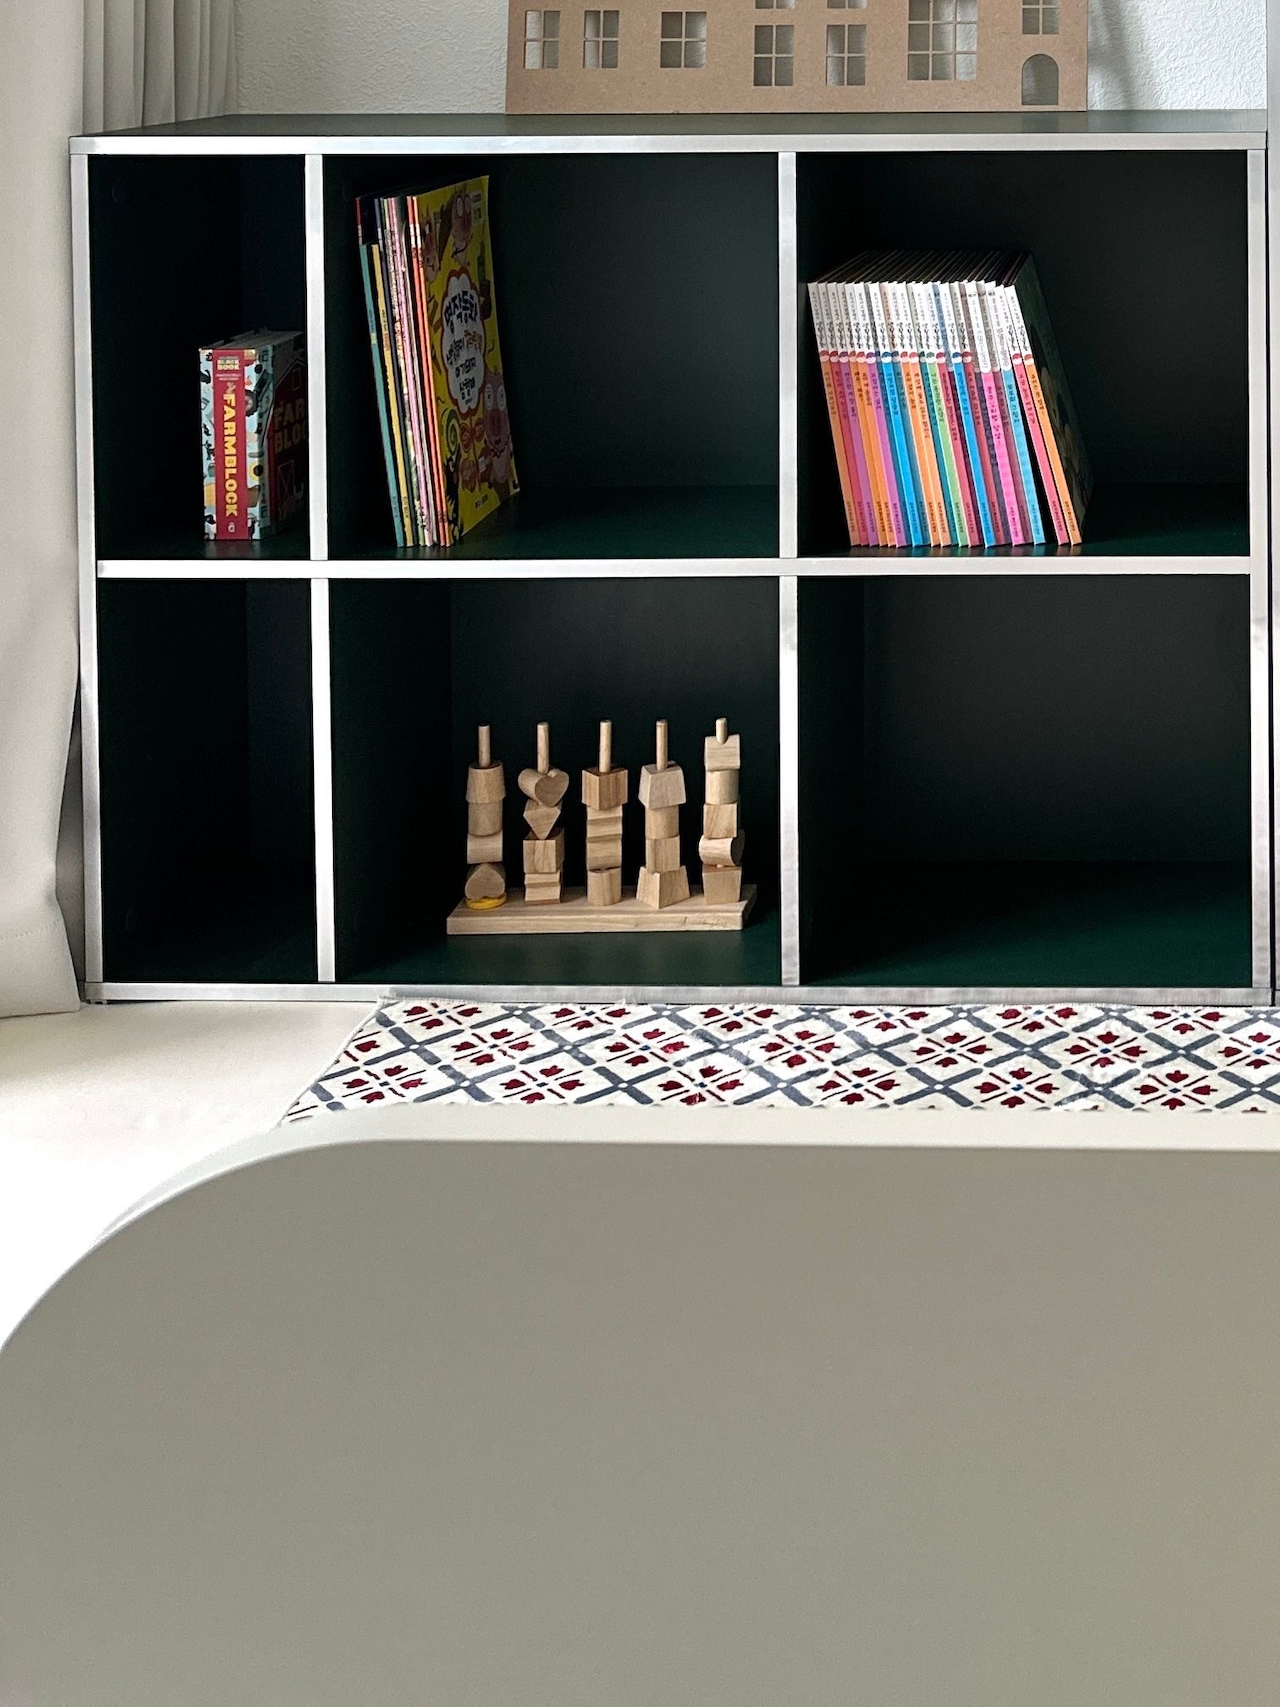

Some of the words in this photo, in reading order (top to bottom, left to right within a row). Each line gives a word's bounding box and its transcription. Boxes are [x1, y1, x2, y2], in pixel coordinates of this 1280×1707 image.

[444, 291, 478, 335] 명작동화
[274, 397, 305, 432] FAR
[223, 393, 238, 517] FARMBLOCK
[275, 424, 305, 456] BLO
